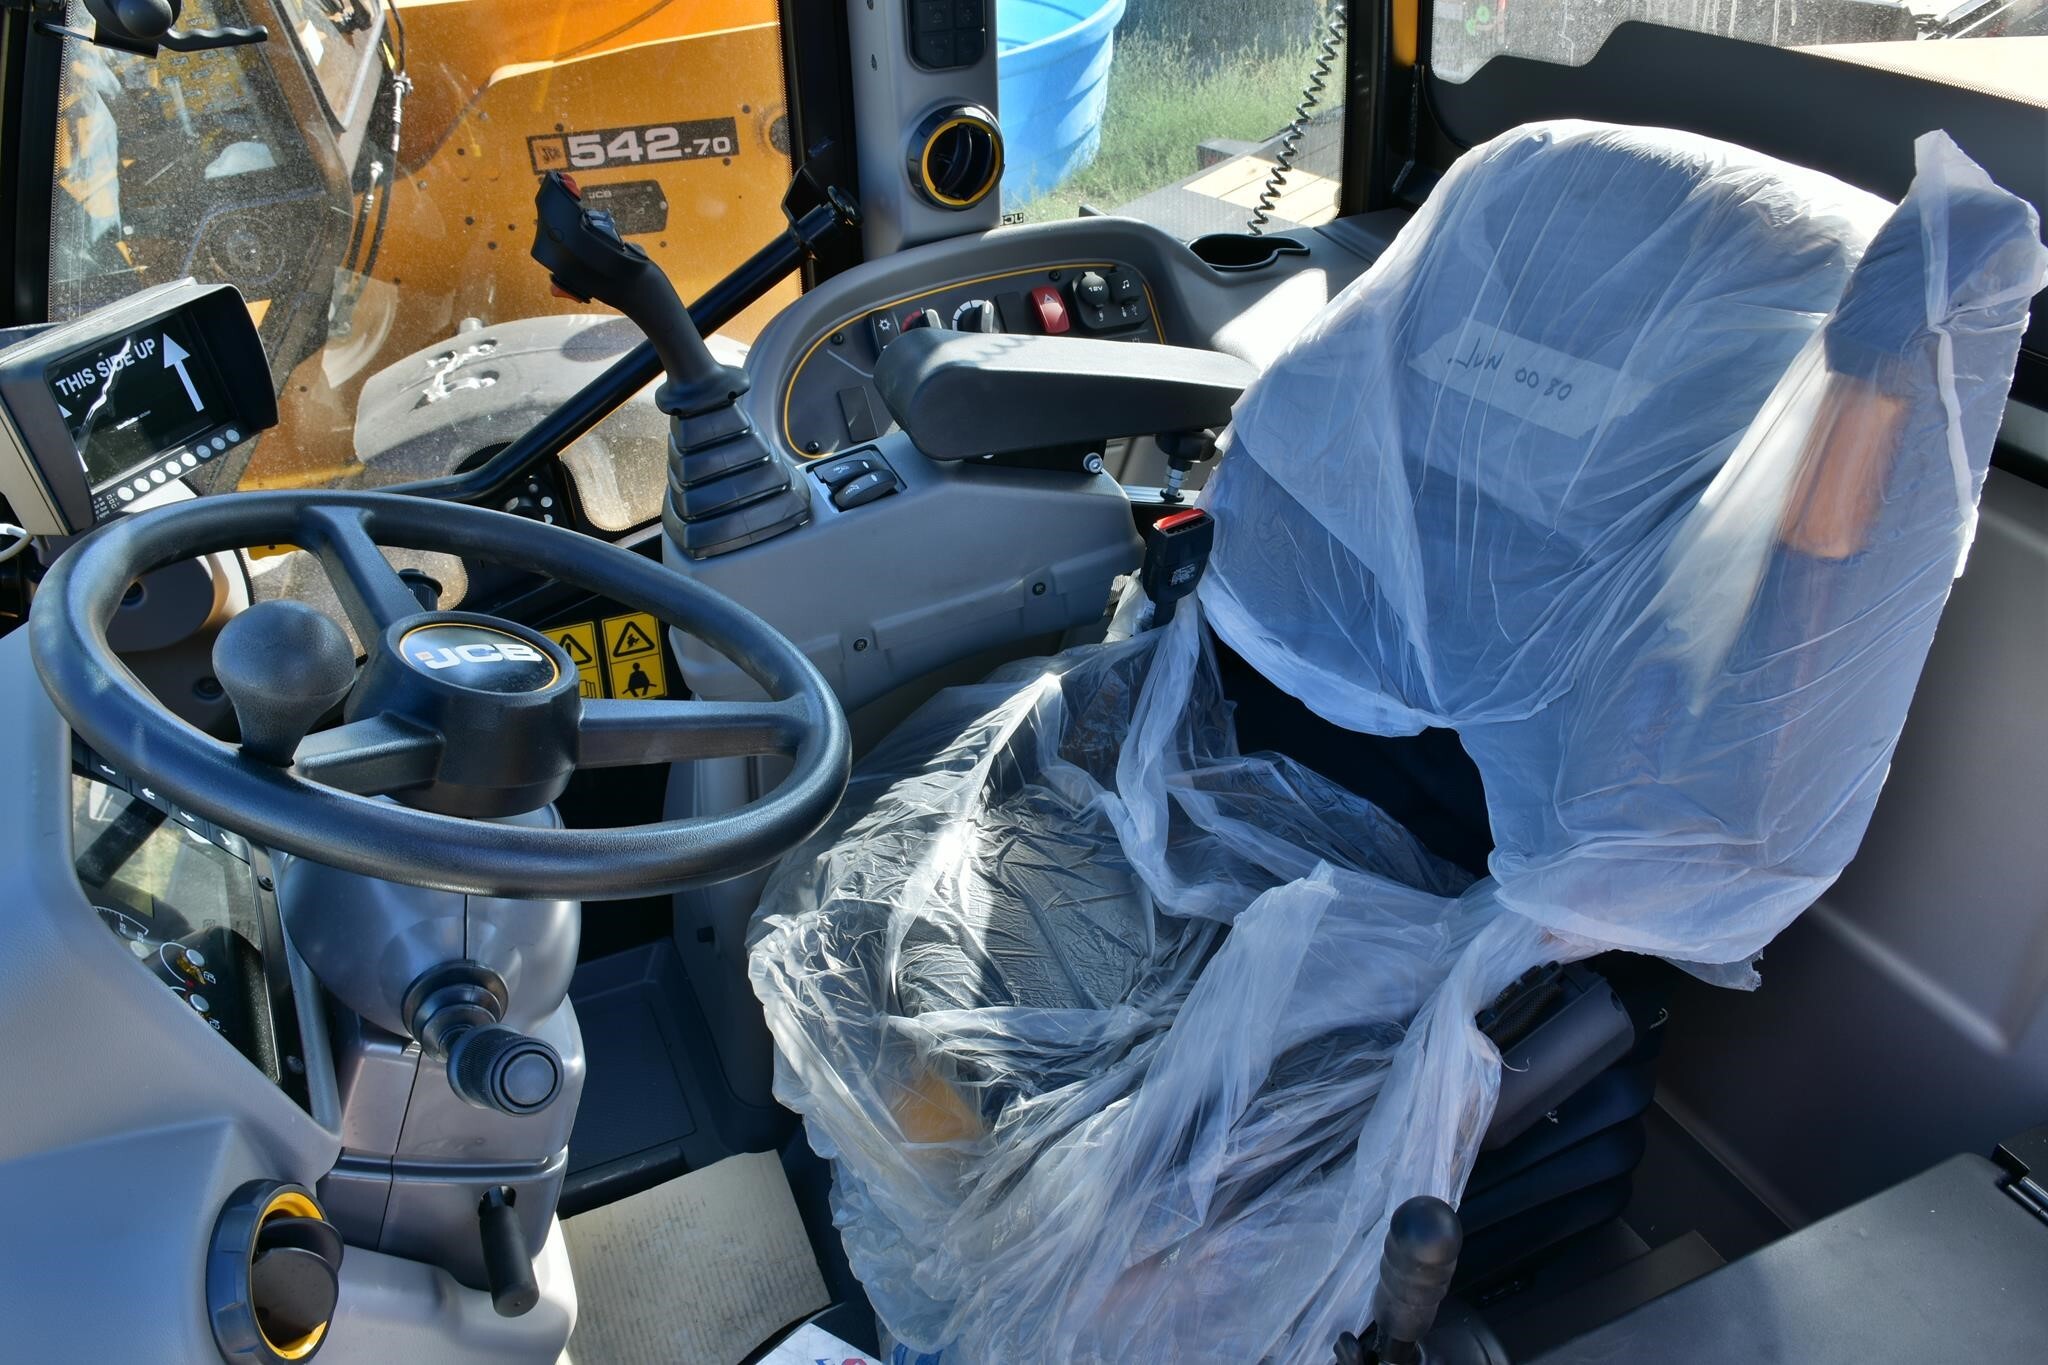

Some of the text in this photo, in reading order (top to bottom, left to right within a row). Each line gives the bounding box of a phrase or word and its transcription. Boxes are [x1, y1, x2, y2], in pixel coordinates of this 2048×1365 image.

[56, 339, 156, 396] THIS SIDE UP
[415, 644, 543, 669] JCB
